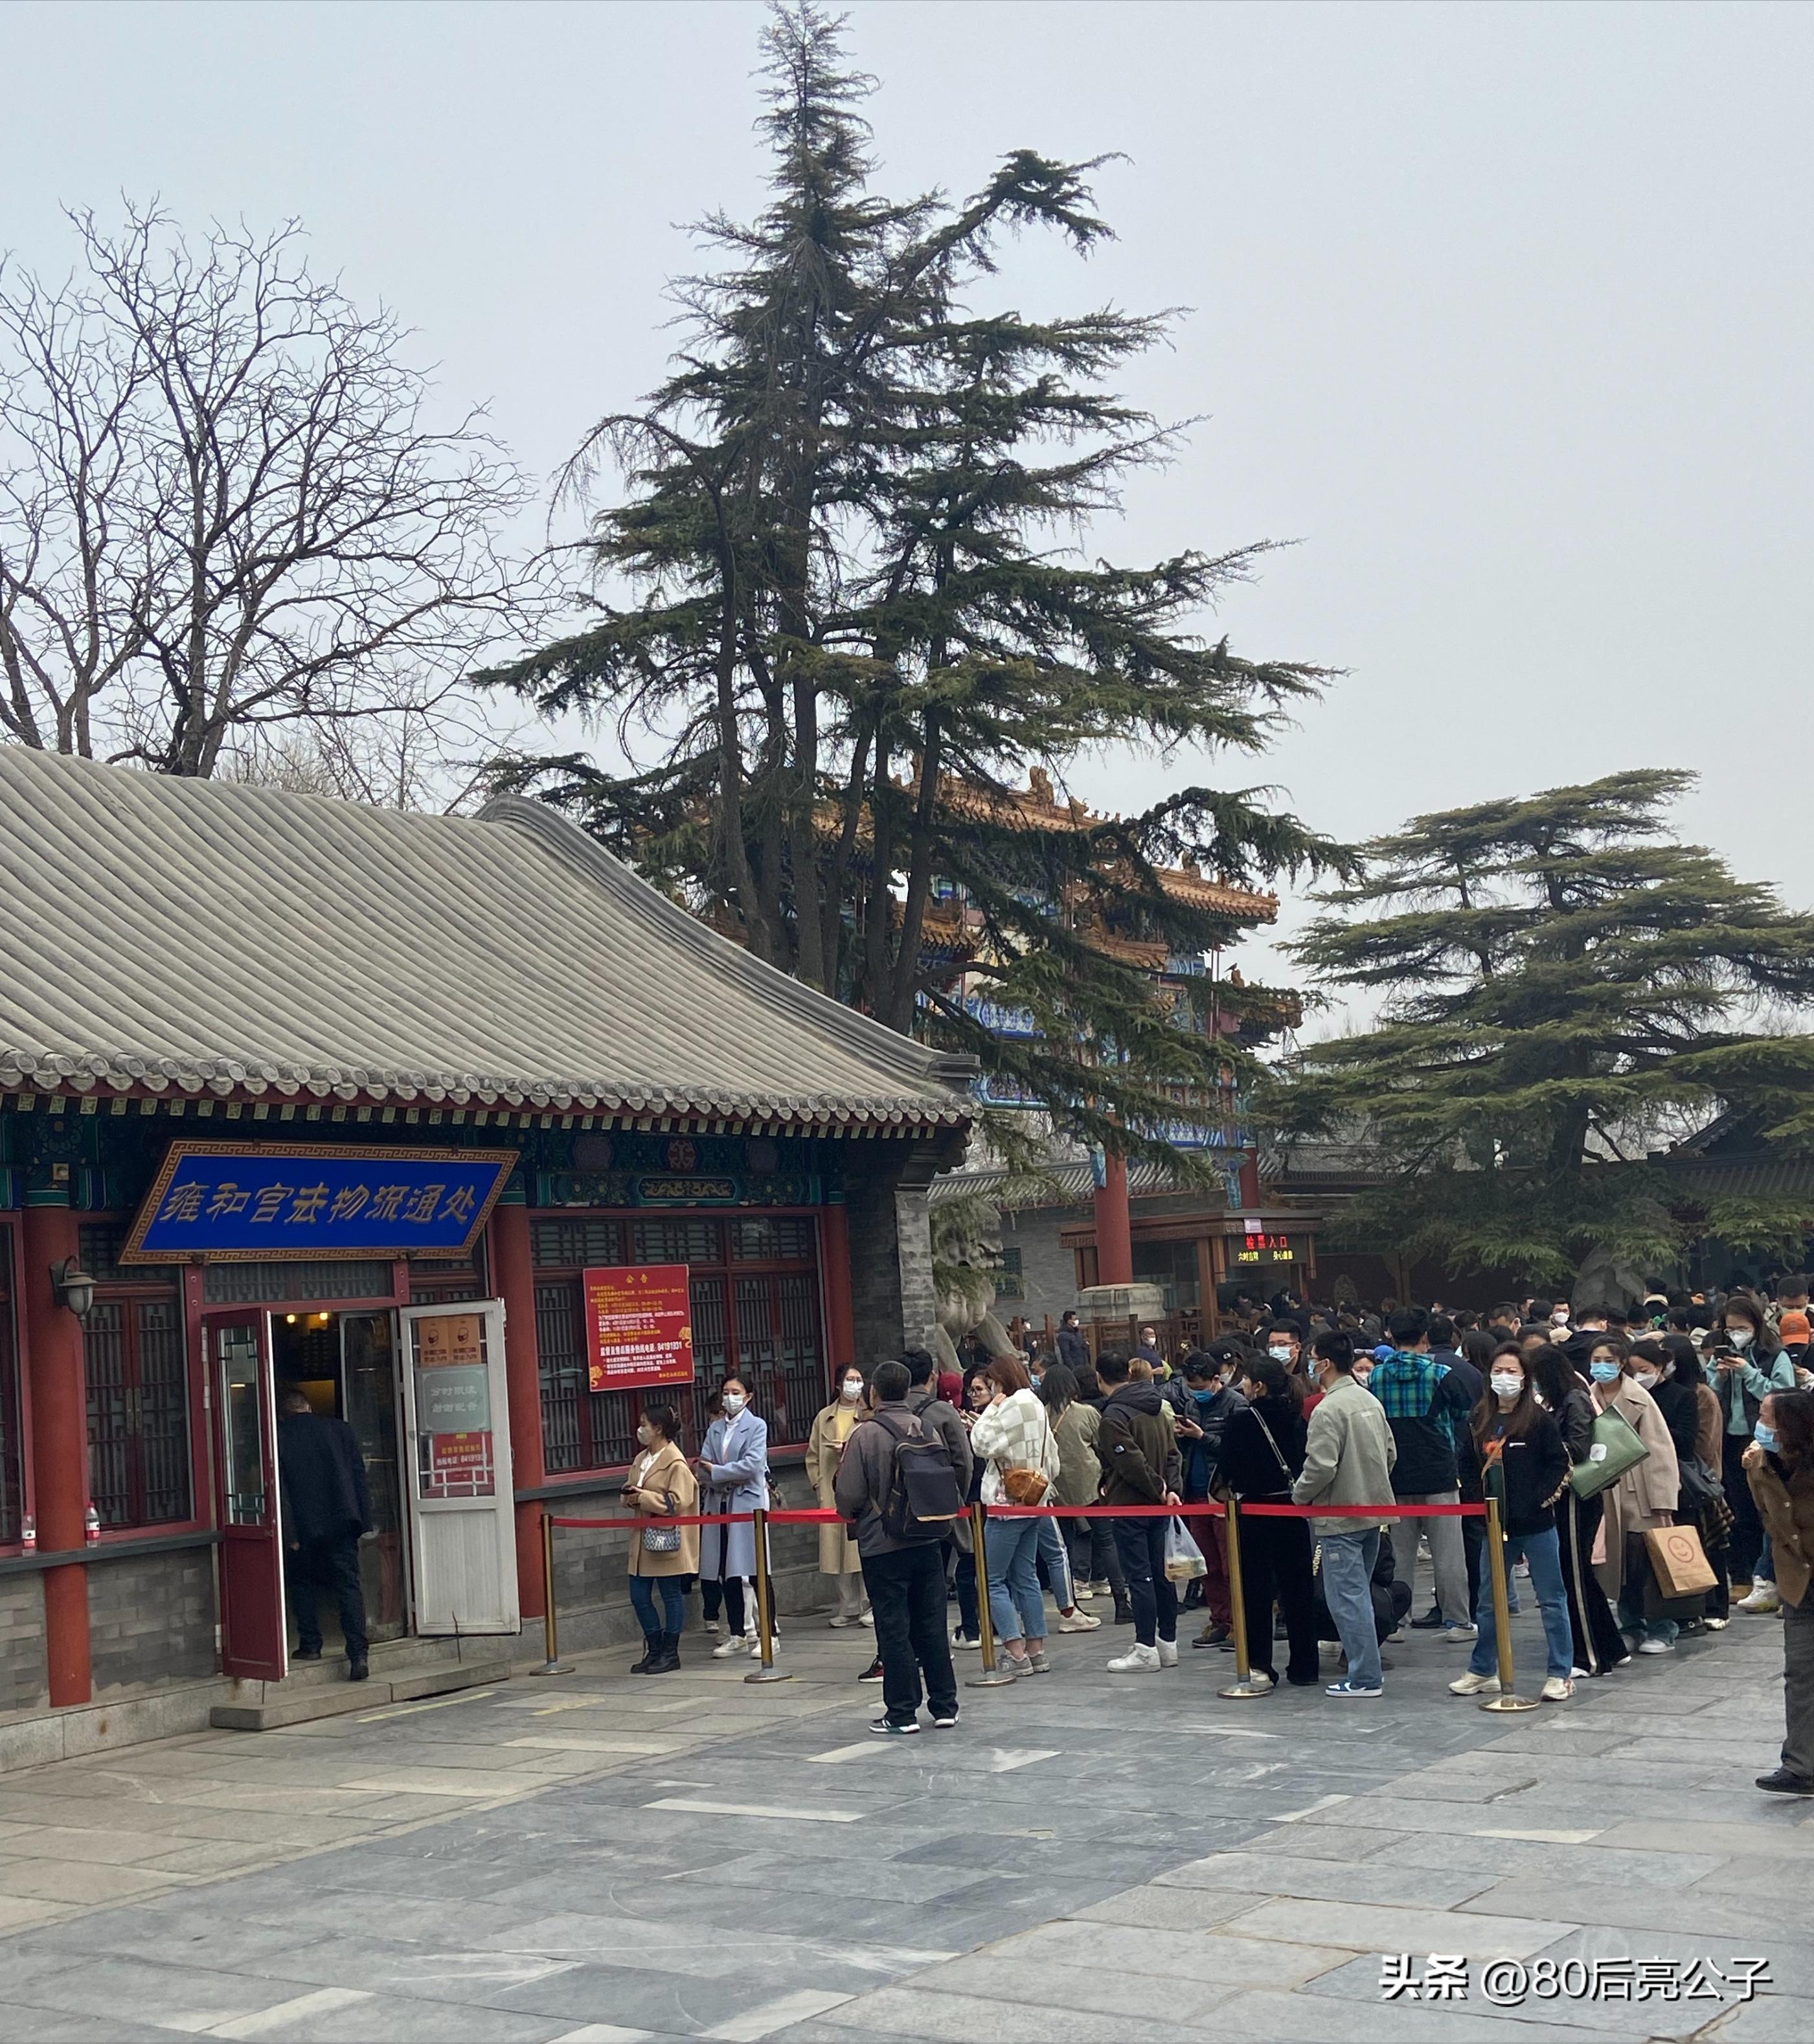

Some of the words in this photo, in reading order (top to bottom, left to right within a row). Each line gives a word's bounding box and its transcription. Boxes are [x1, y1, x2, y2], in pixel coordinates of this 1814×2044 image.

[159, 1181, 475, 1225] 雍和宫法物流通处
[626, 1273, 648, 1284] 公告
